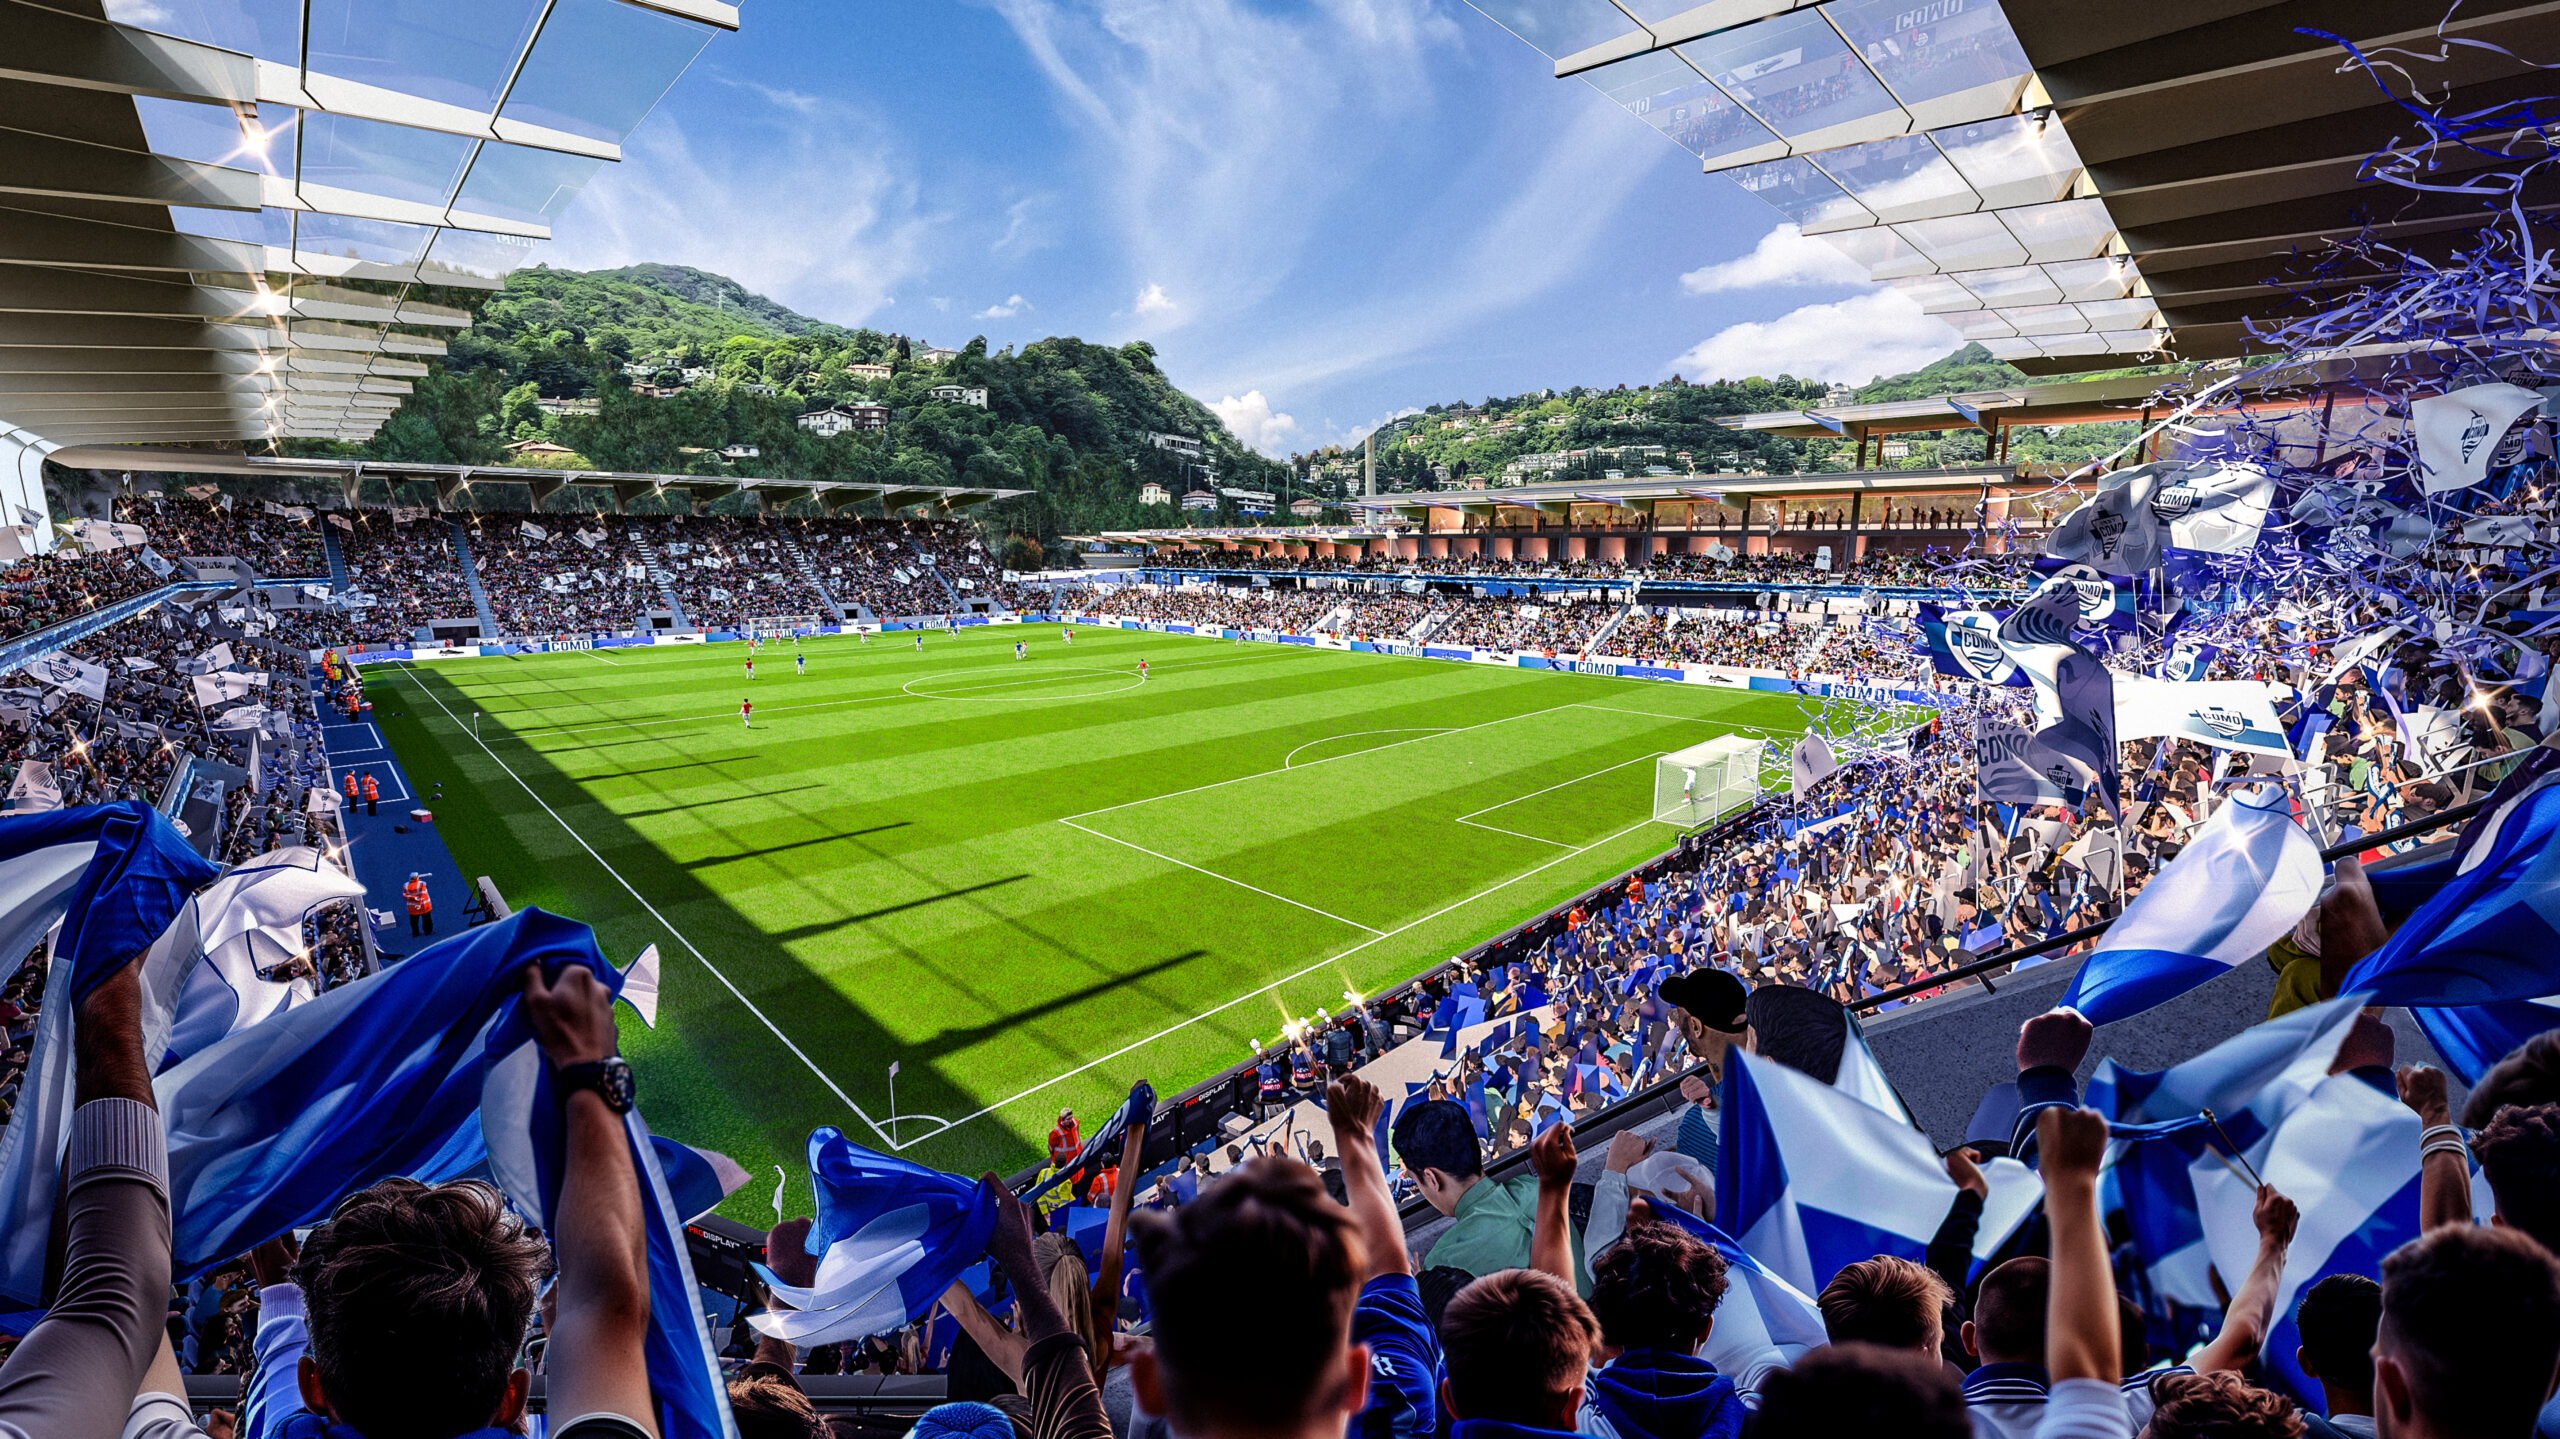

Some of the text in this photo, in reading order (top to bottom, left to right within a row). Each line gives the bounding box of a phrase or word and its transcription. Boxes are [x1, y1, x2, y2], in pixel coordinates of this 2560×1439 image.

[2158, 493, 2190, 506] COMO
[1256, 632, 1277, 643] COMO
[552, 641, 590, 652] COMO
[1394, 645, 1421, 657] COMO
[1578, 661, 1614, 675] COMO
[1834, 684, 1885, 702] COMO
